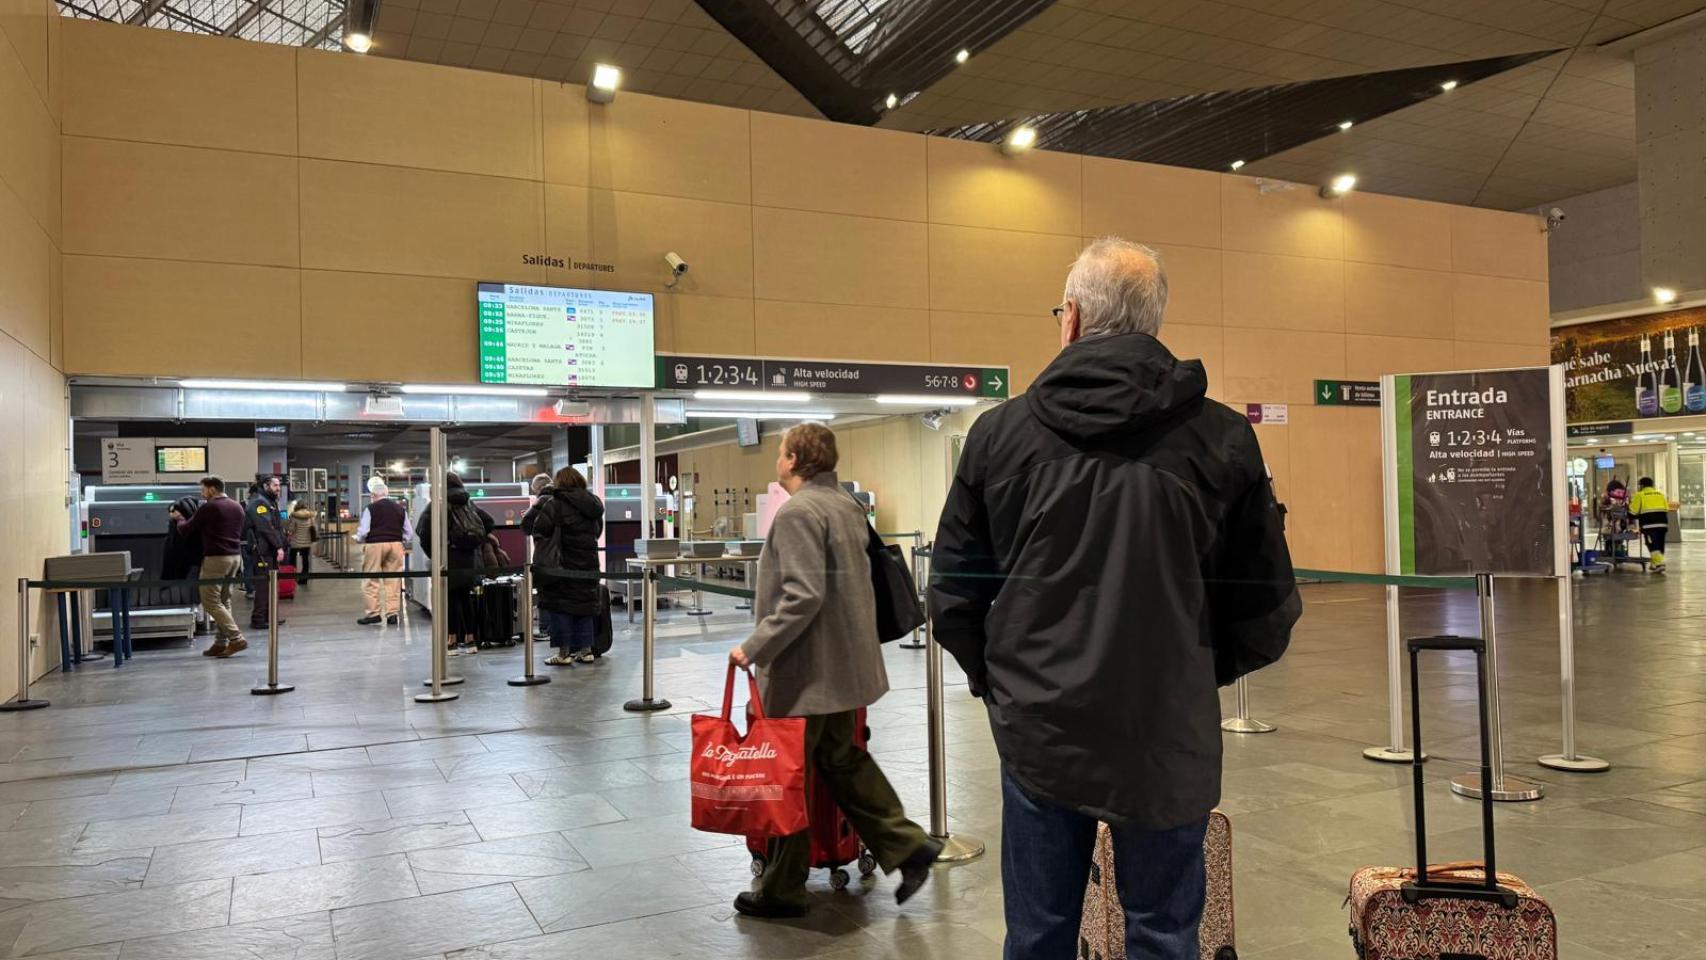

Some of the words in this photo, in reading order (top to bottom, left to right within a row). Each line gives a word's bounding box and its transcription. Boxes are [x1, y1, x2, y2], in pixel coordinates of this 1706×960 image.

[522, 254, 564, 268] Salidas
[573, 262, 615, 273] DEPARTURES
[508, 286, 544, 296] Salidas
[1579, 351, 1612, 369] sabe
[1625, 354, 1676, 377] Nueva?
[793, 367, 813, 378] Alta
[815, 369, 860, 380] velocidad
[1426, 387, 1508, 406] Entrada
[1426, 408, 1485, 420] ENTRANCE
[1506, 428, 1525, 436] Vías
[108, 451, 119, 468] 3
[1429, 450, 1448, 459] Alta
[1450, 449, 1494, 458] velocidad
